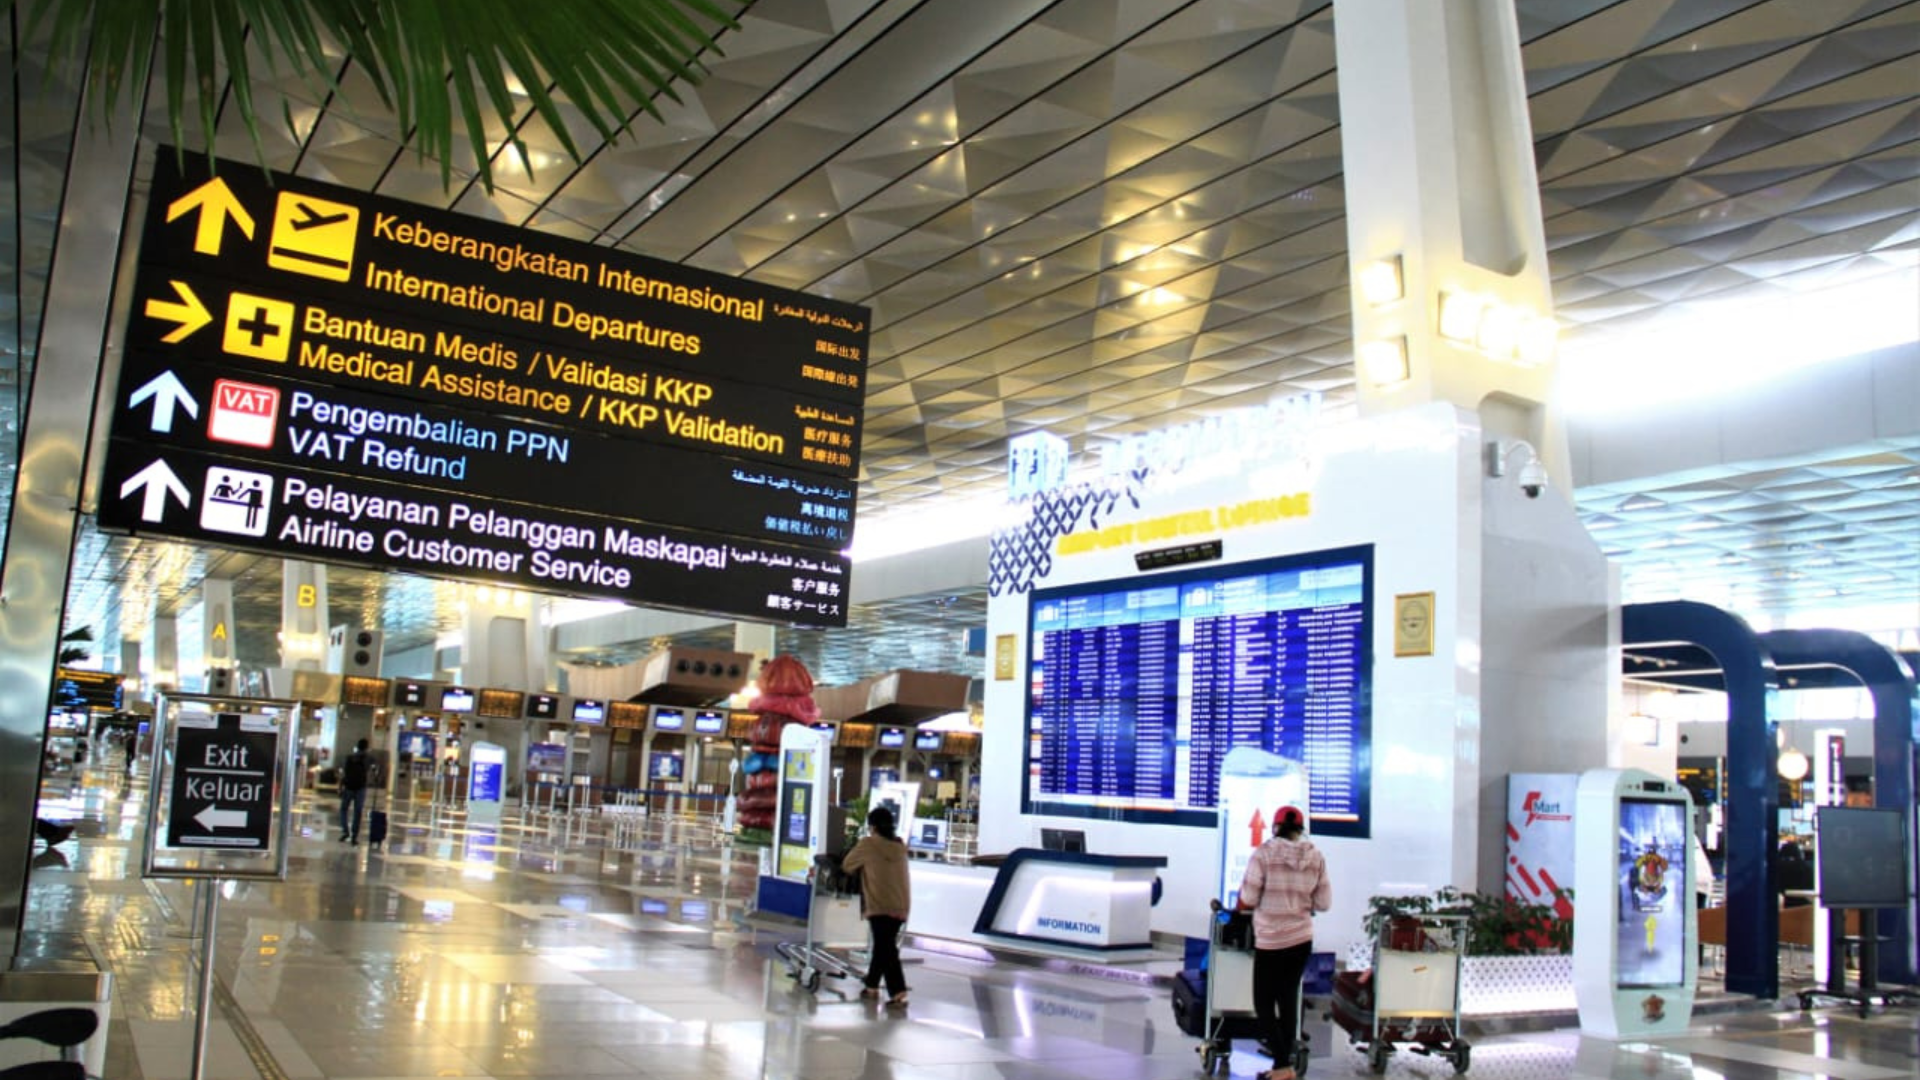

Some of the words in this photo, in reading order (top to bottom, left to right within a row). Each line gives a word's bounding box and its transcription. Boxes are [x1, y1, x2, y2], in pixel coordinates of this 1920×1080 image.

[373, 212, 588, 283] Keberangkatan
[598, 262, 764, 321] Internasional
[365, 261, 545, 322] International
[552, 301, 701, 354] Departures
[303, 306, 426, 353] Bantuan
[434, 331, 518, 370] Medis
[527, 351, 541, 376] /
[546, 353, 648, 397] Validasi
[654, 375, 713, 408] KKP
[815, 339, 860, 361] 国际出发
[223, 387, 271, 413] VAT
[299, 341, 413, 386] Medical
[420, 364, 572, 414] Assistance
[579, 394, 594, 419] /
[598, 396, 660, 429] KKP
[663, 408, 785, 455] Validation
[290, 391, 498, 450] Pengembalian
[506, 428, 570, 463] PPN
[804, 426, 852, 448] 医疗服务
[287, 426, 355, 461] VAT
[362, 438, 467, 481] Refund
[283, 477, 440, 527] Pelayanan
[449, 502, 596, 551] Pelanggan
[603, 526, 728, 572] Maskapai
[279, 514, 374, 553] Airline
[383, 528, 525, 573] Customer
[530, 549, 632, 589] Service
[297, 584, 316, 607] B
[792, 577, 841, 597] 客户服务
[767, 594, 839, 615] 顧客サービス
[212, 622, 227, 640] A
[204, 743, 248, 768] Exit
[185, 777, 263, 801] Keluar
[1037, 918, 1101, 934] INFORMATION
